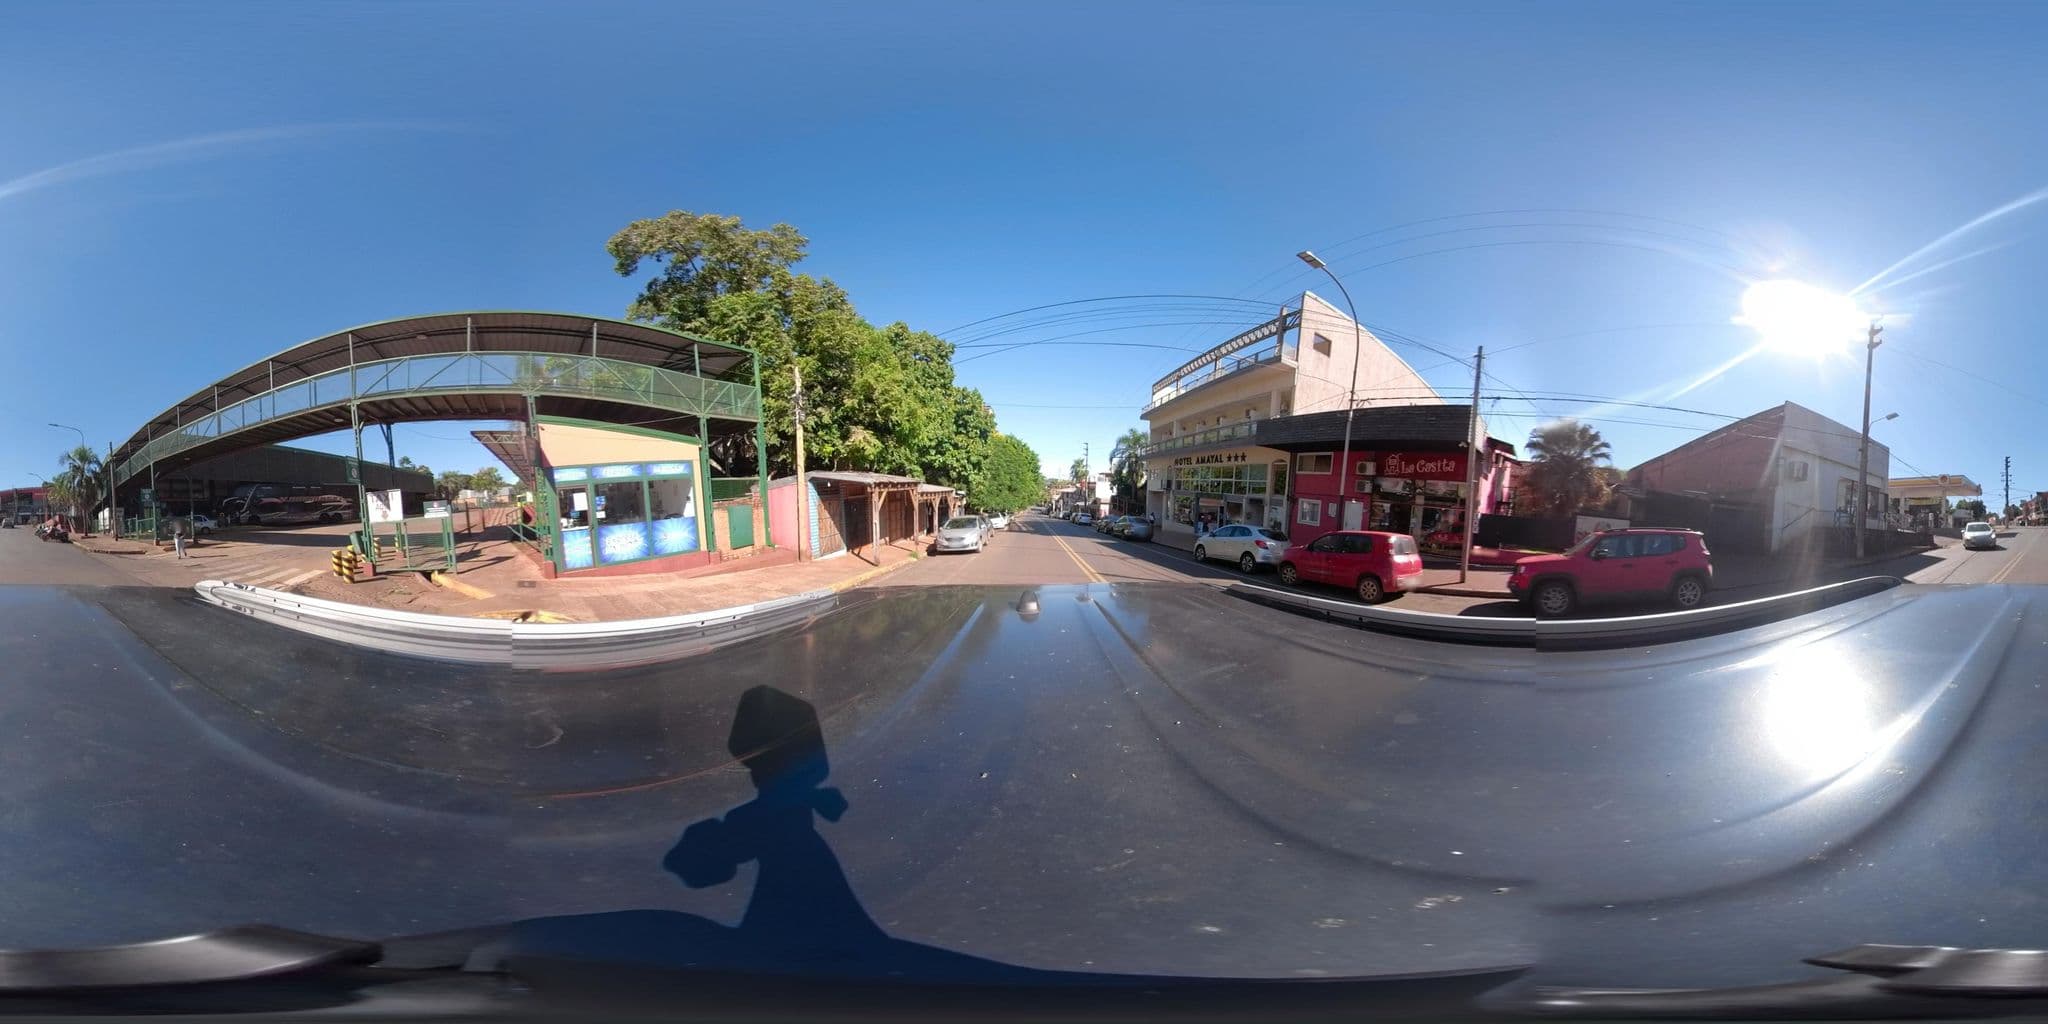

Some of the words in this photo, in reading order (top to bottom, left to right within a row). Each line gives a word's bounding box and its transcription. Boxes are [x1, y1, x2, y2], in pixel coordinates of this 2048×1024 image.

[1174, 457, 1193, 466] HOTEL
[1195, 454, 1224, 464] AMAYAL
[1401, 461, 1415, 474] La
[1416, 459, 1457, 473] Casita
